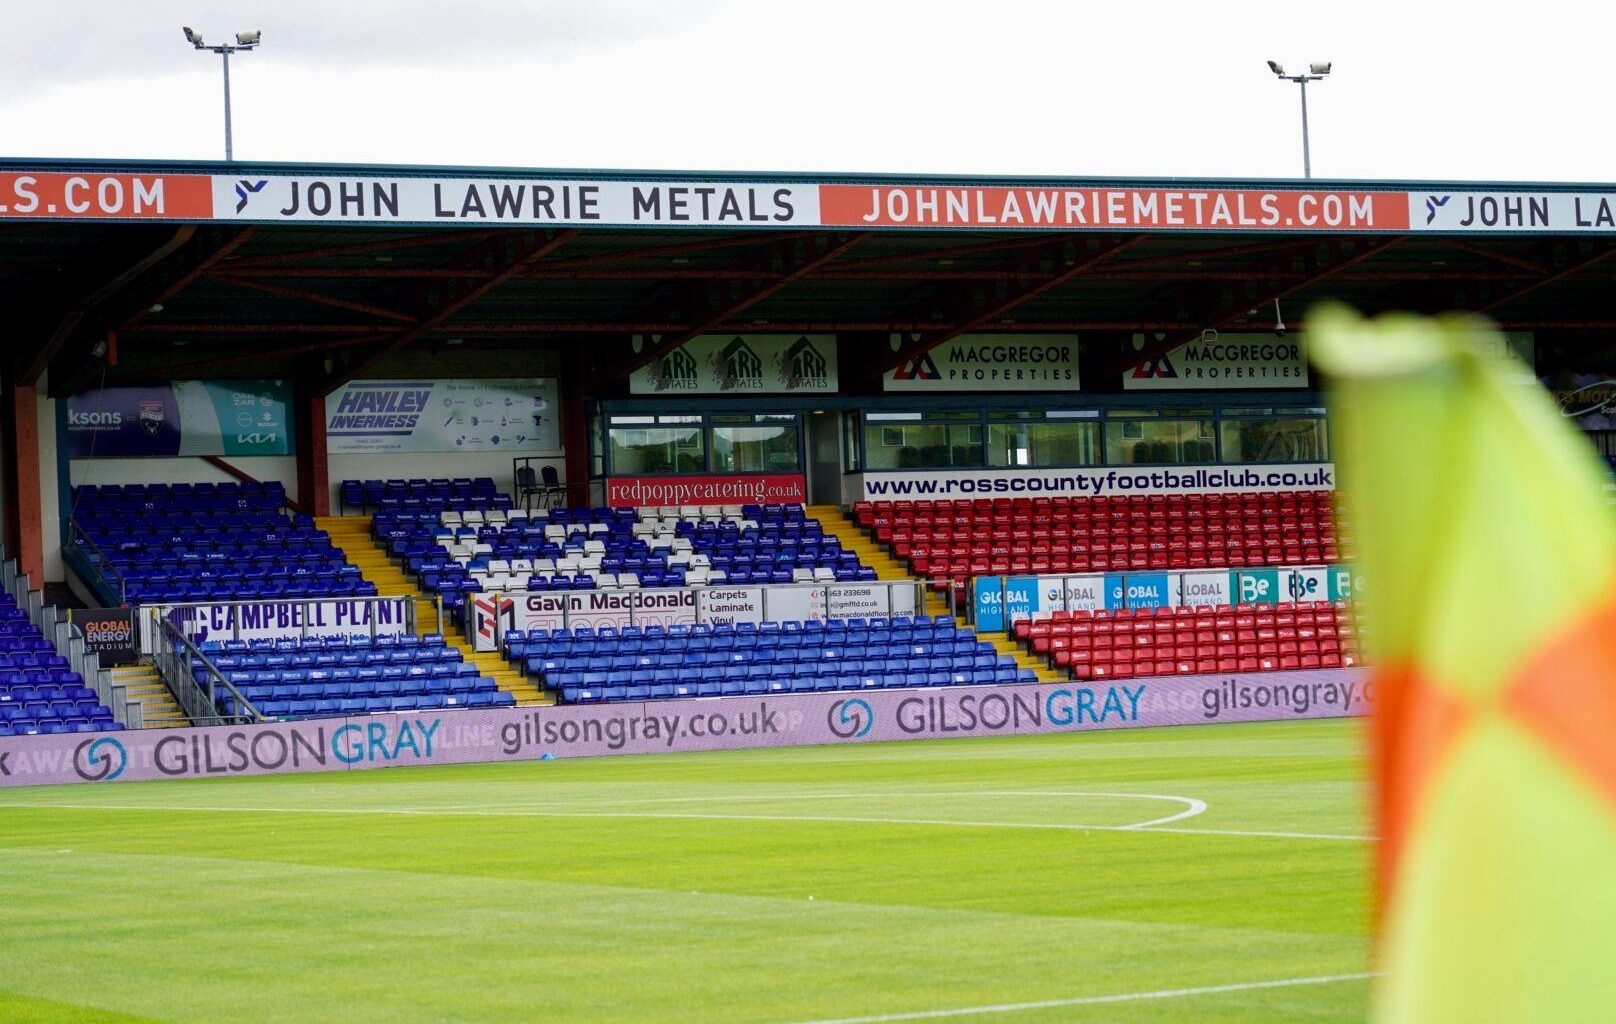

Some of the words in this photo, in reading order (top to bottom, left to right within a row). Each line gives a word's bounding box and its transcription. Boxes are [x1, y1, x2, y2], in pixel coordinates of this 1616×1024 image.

[280, 181, 399, 217] JOHN
[433, 183, 601, 220] LAWRIE
[632, 186, 795, 222] METALS
[862, 188, 1375, 227] JOHNLAWRIEMETALS.COM
[1459, 196, 1549, 227] JOHN
[949, 346, 1071, 363] MACGREGOR
[1185, 344, 1300, 362] MACGREGOR
[949, 369, 1072, 380] PROPERTIES
[1185, 366, 1300, 378] PROPERTIES
[336, 391, 431, 413] HAYLEY
[69, 409, 122, 425] ksons
[328, 415, 421, 429] INVERNESS
[865, 468, 1333, 496] www.rosscountyfootballclub.co.uk
[611, 479, 802, 505] redpoppycatering.co.uk
[843, 588, 871, 597] 233698
[1112, 585, 1160, 599] GOBAL
[1241, 575, 1270, 601] Be
[1288, 573, 1318, 598] Be
[589, 590, 696, 610] Macdonald
[709, 590, 748, 600] Carpets
[209, 602, 327, 631] CAMPBELL
[335, 599, 405, 627] PLANT
[709, 604, 754, 612] Laminate
[86, 620, 129, 632] GLOBAL
[87, 630, 130, 642] ENERGY
[87, 643, 132, 651] STADIUM
[500, 701, 781, 755] gilsongray.co.uk
